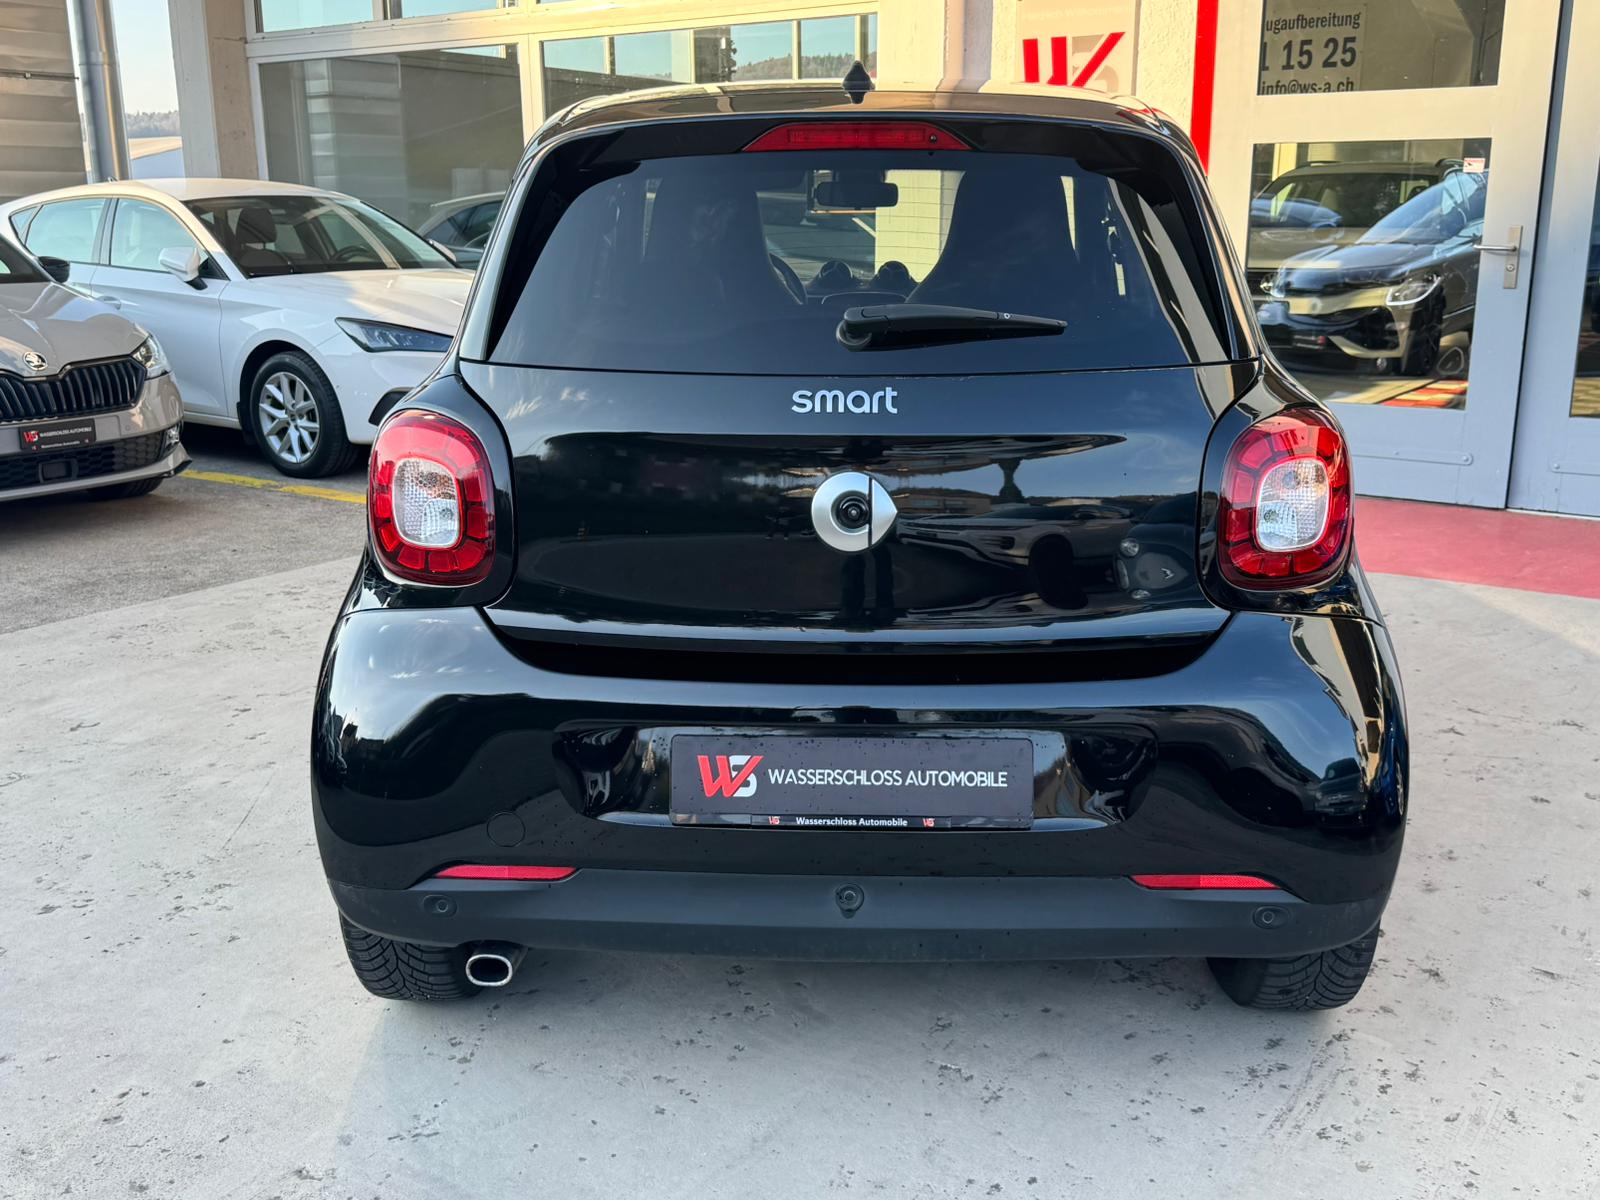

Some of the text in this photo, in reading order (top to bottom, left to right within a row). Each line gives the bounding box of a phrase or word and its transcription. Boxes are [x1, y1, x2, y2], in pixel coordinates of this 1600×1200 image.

[1265, 12, 1362, 34] ugaufbereitung
[1281, 39, 1313, 70] 15
[1322, 36, 1357, 68] 25
[791, 387, 898, 414] smart
[697, 755, 764, 798] WS
[768, 768, 1009, 788] WASSERSCHLOSS AUTOMOBILE
[796, 816, 857, 826] Wasserschloss
[858, 817, 908, 827] Automobile
